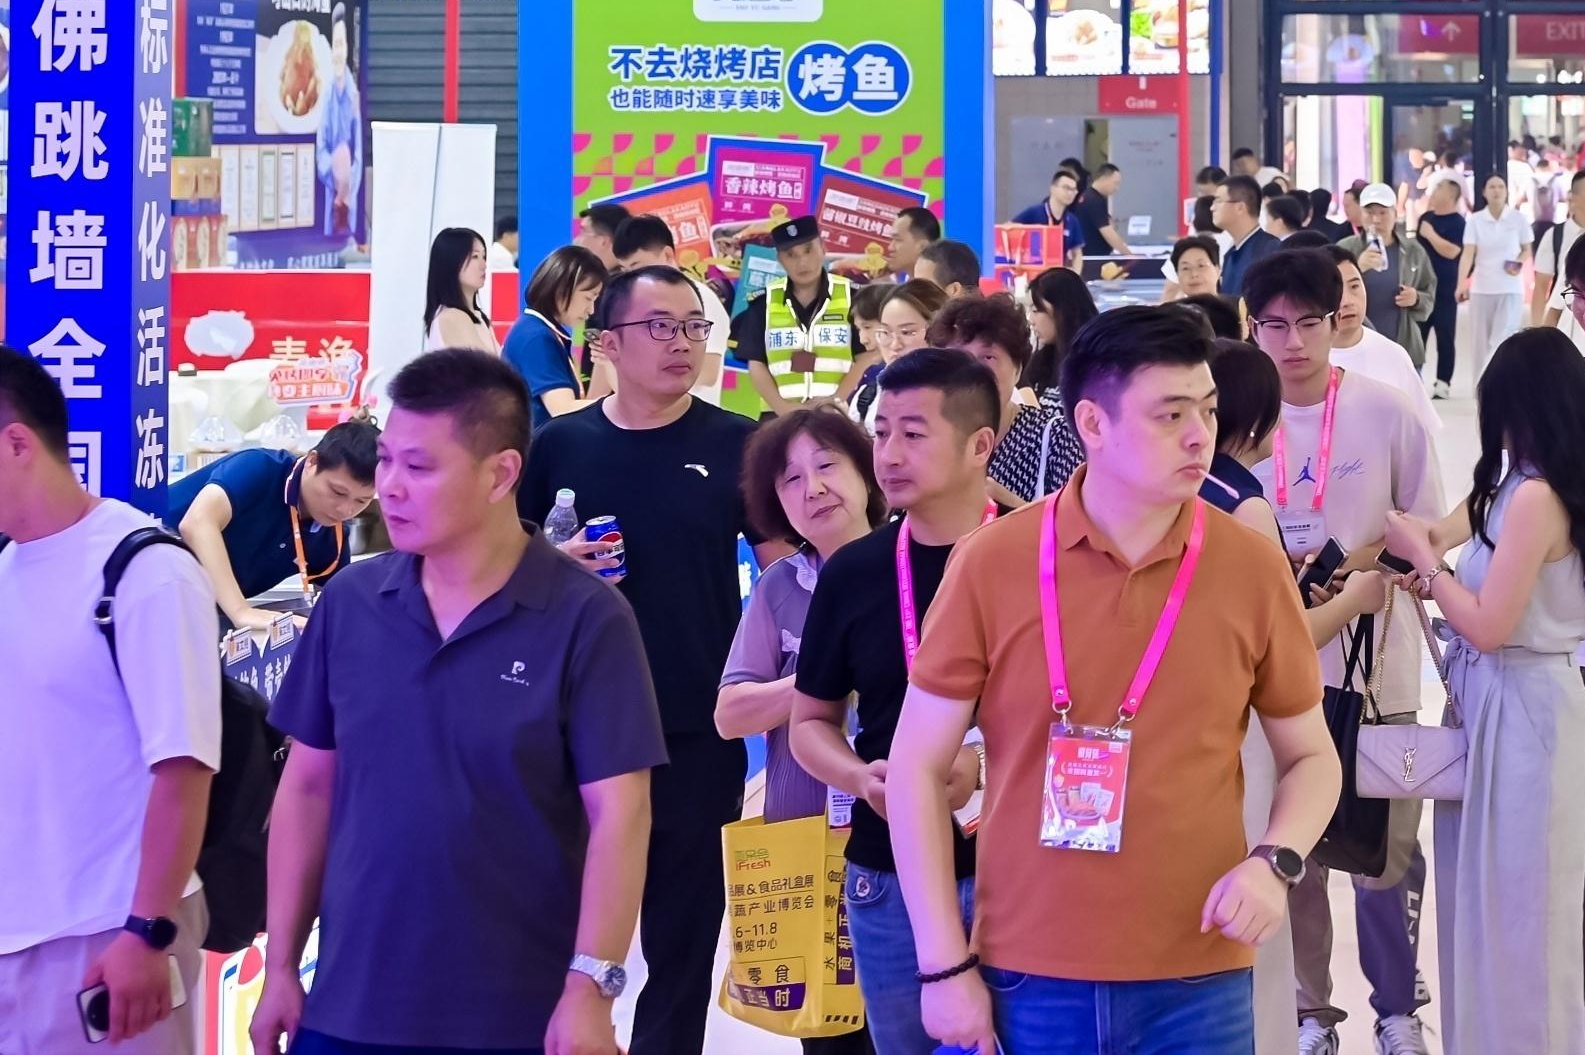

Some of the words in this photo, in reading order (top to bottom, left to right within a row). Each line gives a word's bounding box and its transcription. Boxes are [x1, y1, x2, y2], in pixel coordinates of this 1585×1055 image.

[610, 47, 782, 81] 不去烧烤店
[797, 53, 899, 103] 烤鱼
[610, 88, 782, 110] 也能随时速享美味
[1125, 96, 1158, 110] Gate
[724, 177, 794, 199] 香辣烤鱼
[768, 331, 799, 348] 浦东
[818, 327, 848, 345] 保安
